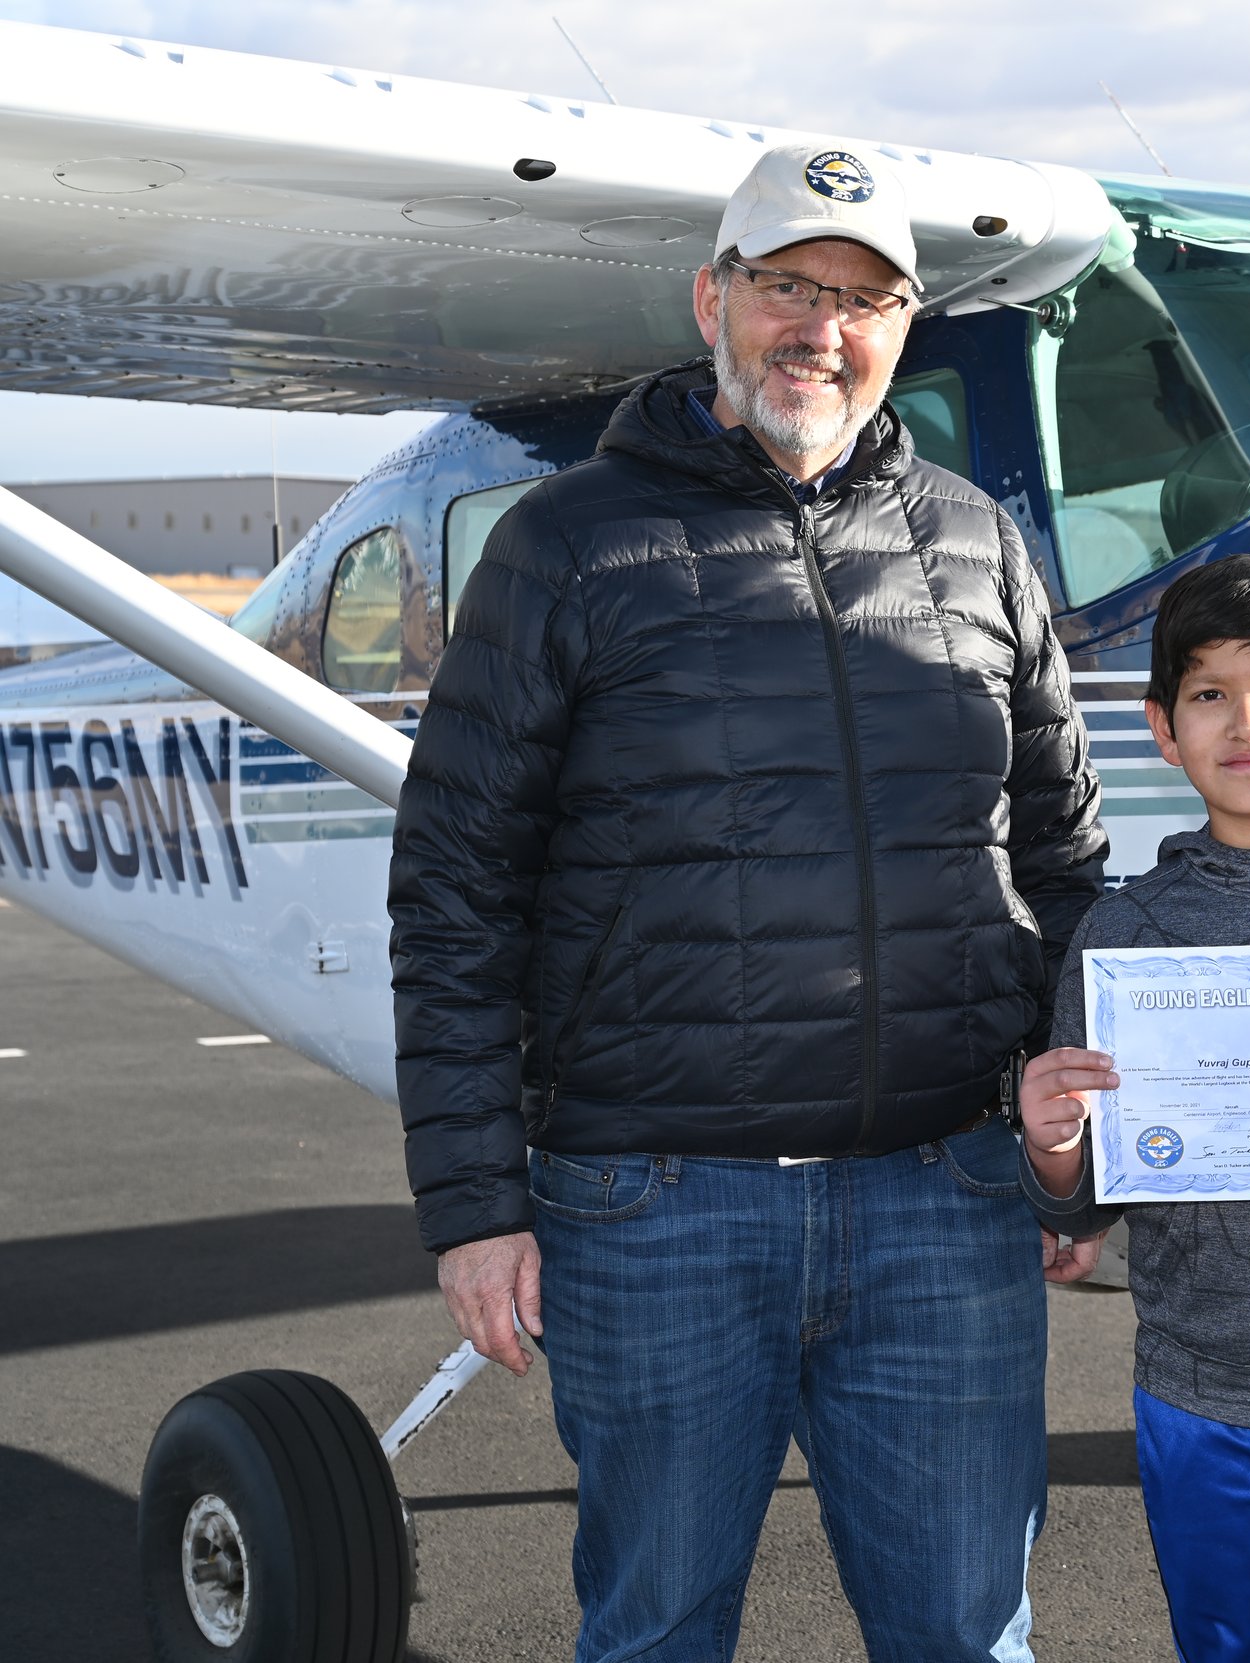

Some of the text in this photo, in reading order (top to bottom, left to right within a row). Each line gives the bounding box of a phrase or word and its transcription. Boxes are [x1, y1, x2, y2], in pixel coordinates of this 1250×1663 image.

[812, 153, 840, 167] YOUNG
[1129, 990, 1196, 1010] YOUNG
[1198, 1058, 1229, 1069] Yuvraj
[1140, 1128, 1179, 1143] YOUNG EAGLES
